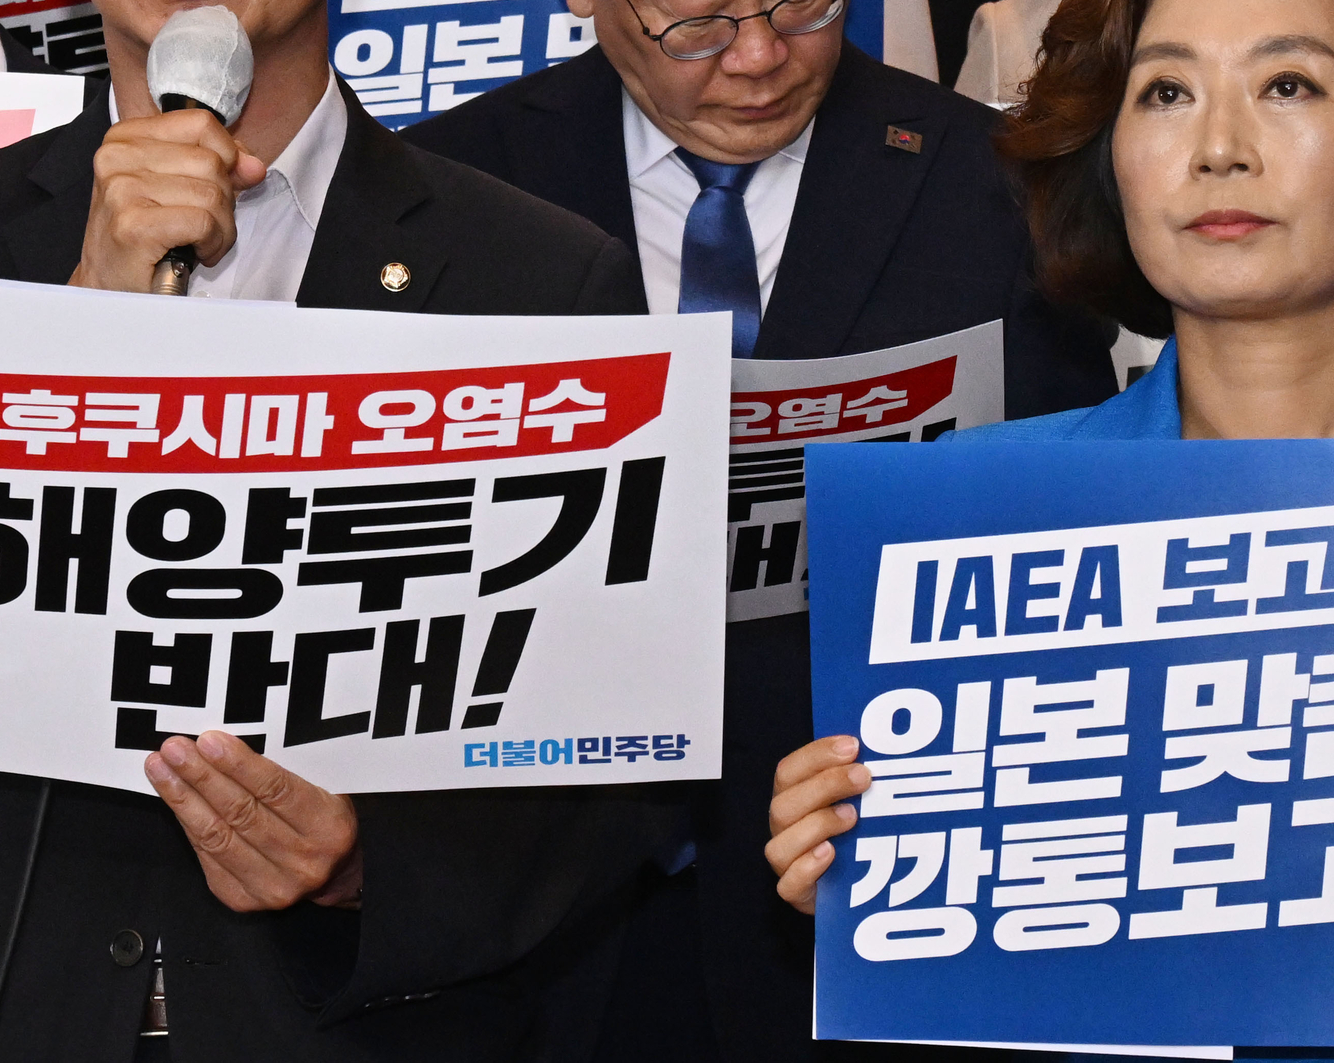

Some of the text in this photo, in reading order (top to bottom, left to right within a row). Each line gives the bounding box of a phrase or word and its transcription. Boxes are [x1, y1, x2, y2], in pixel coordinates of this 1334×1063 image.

[334, 20, 524, 119] 일본
[350, 379, 608, 456] 오염수
[909, 544, 1123, 645] IAEA
[110, 607, 537, 756] 반대!
[463, 734, 691, 769] 더불어민주당
[858, 667, 1129, 819] 일본
